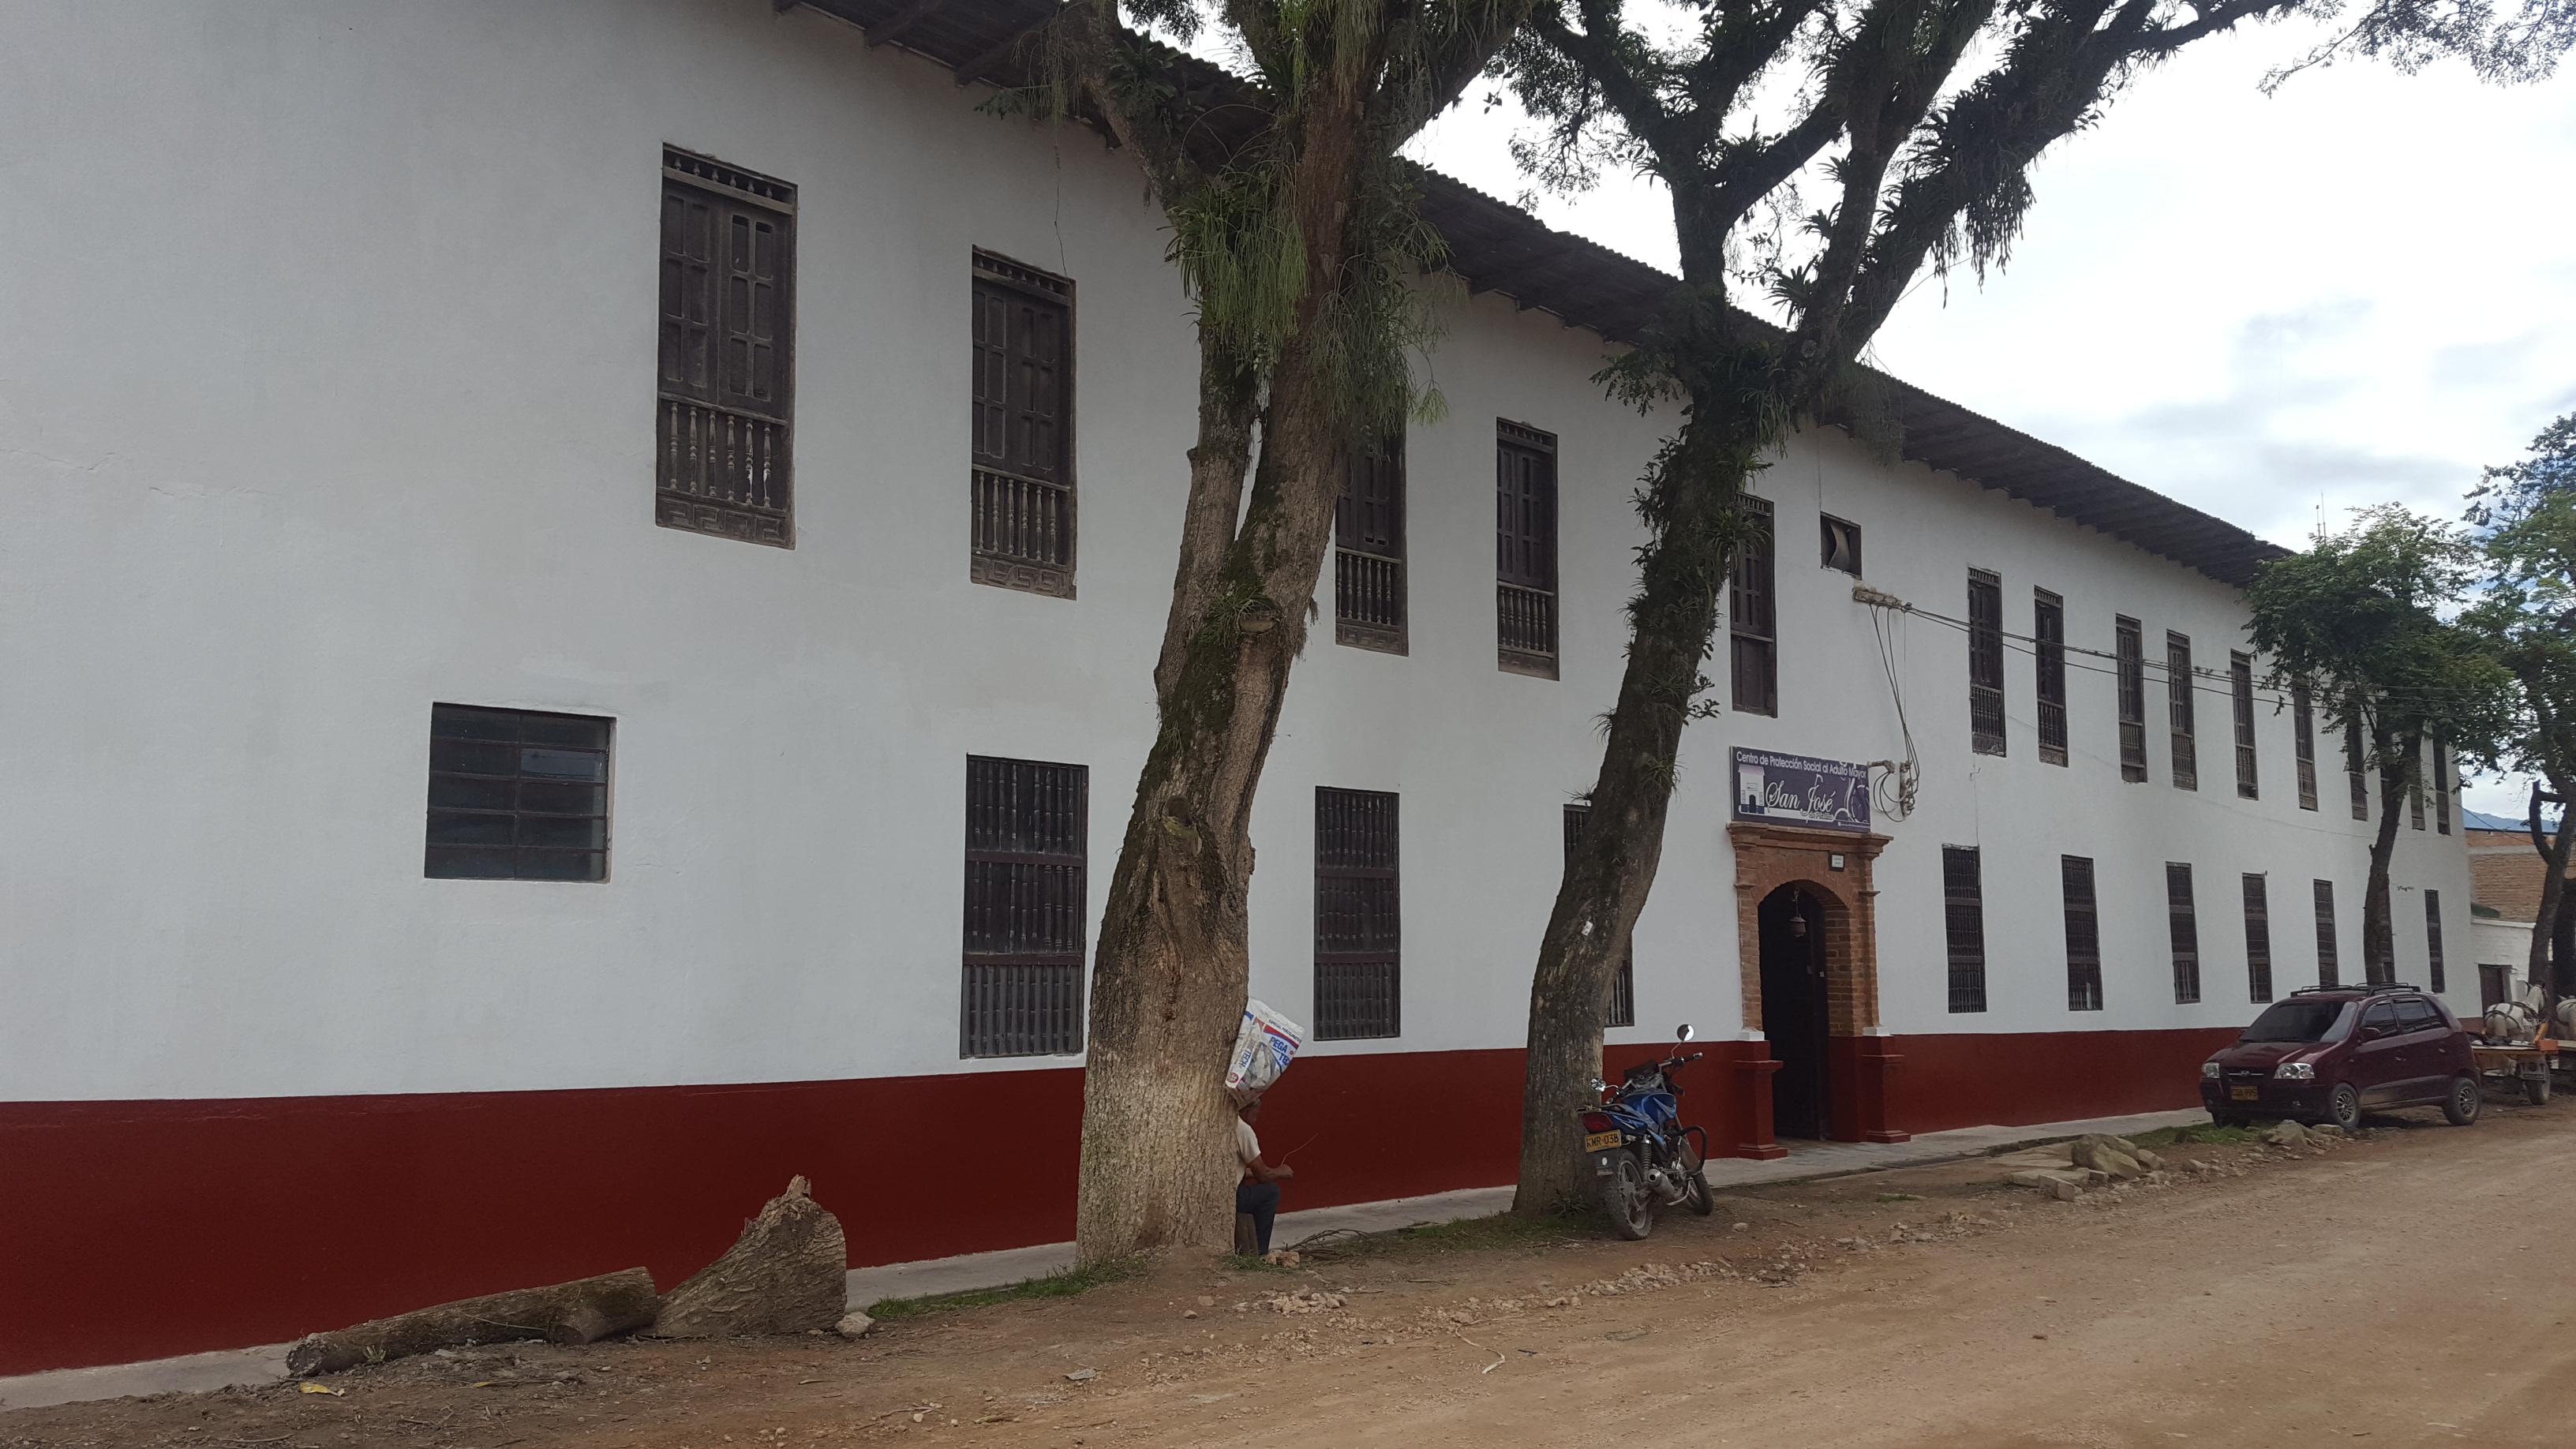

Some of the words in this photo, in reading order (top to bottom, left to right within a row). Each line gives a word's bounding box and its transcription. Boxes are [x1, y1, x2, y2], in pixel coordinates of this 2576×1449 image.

[1735, 751, 1758, 765] Centro
[1759, 754, 1769, 766] de
[1769, 755, 1803, 770] Protección
[1803, 760, 1822, 773] Social
[1822, 762, 1829, 773] al
[1829, 764, 1848, 777] Adulto
[1849, 766, 1866, 780] Mayor
[1765, 780, 1800, 813] San
[1800, 783, 1837, 817] José
[1269, 1036, 1288, 1053] PEGA
[1240, 1050, 1252, 1067] TECH
